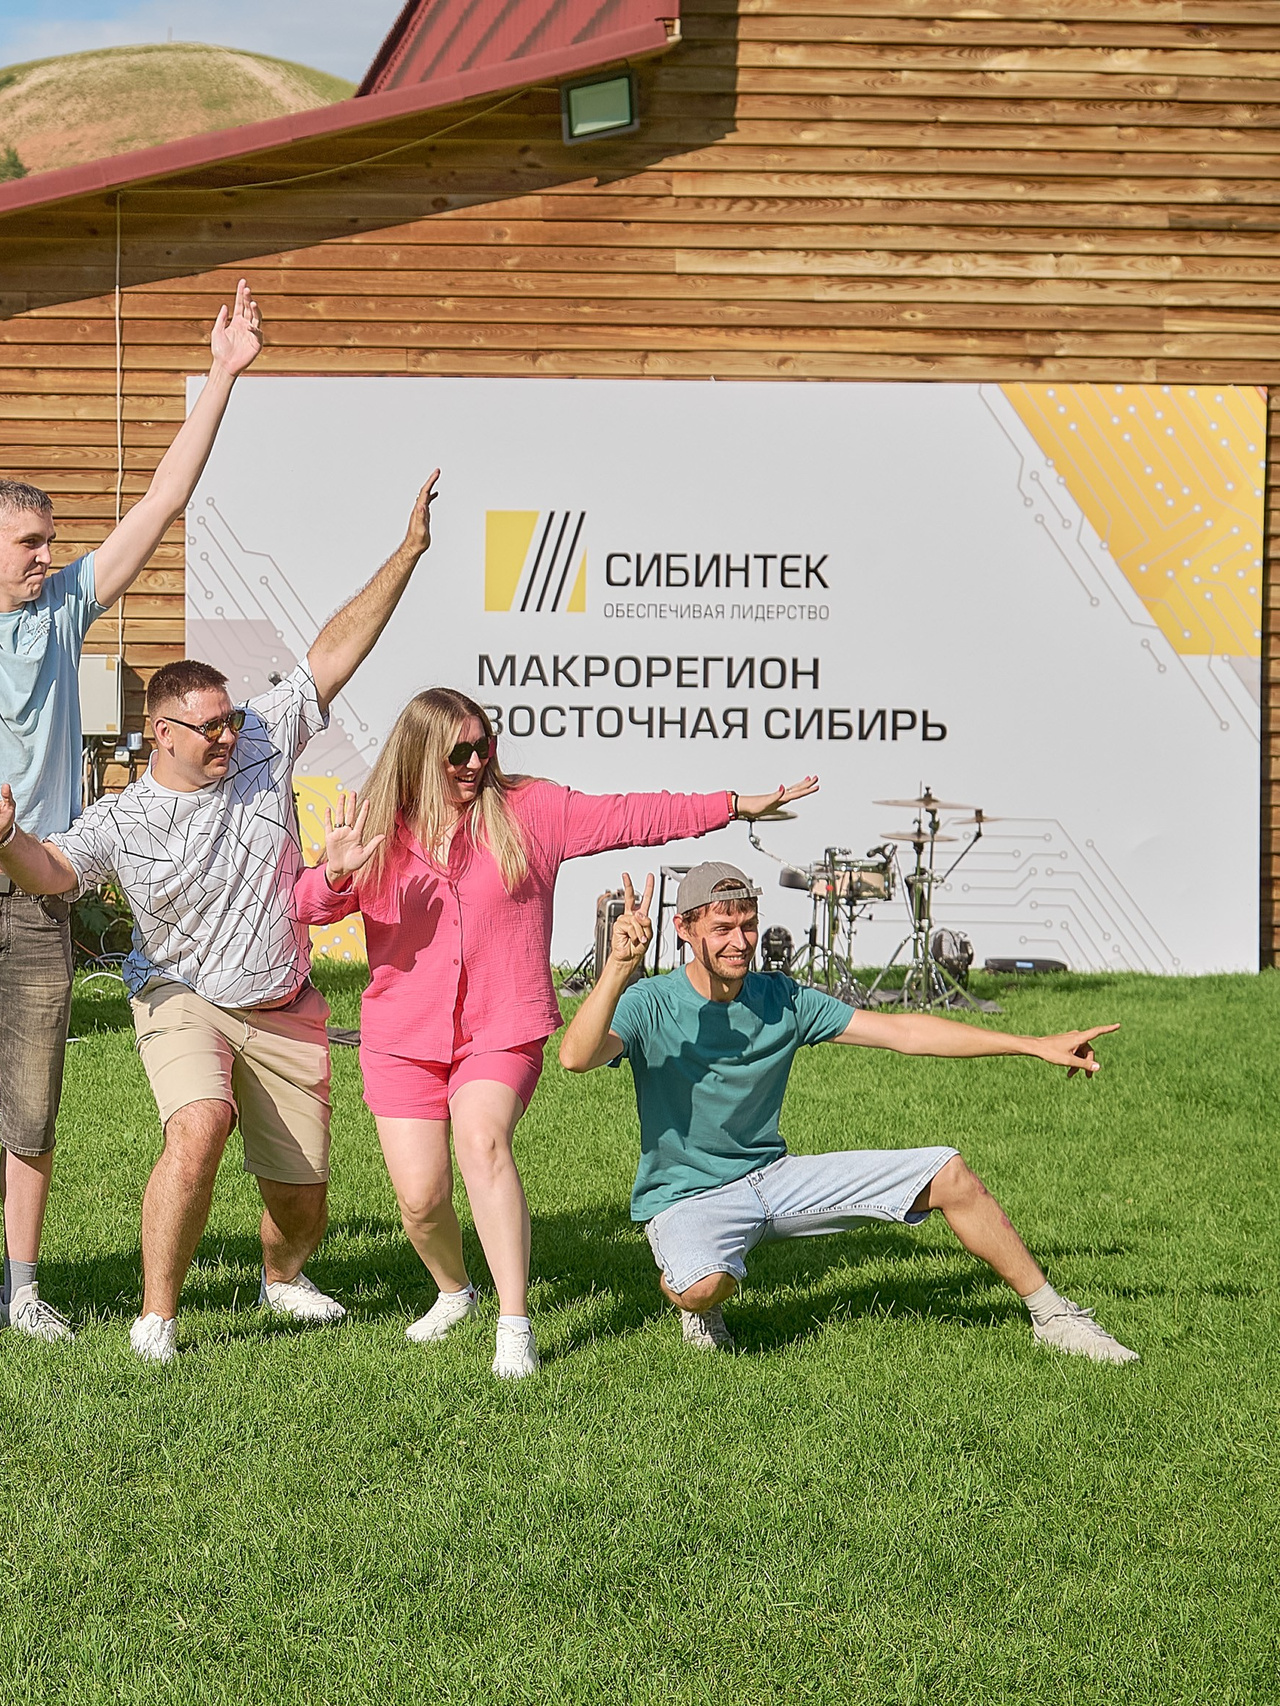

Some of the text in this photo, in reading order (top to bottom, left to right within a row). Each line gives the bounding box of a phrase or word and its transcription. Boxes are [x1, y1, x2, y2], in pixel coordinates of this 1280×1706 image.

[605, 553, 830, 589] СИБИНТЕК
[603, 603, 830, 622] ОБЕСПЕЧИВАЯ ЛИДЕРСТВО
[478, 654, 820, 690] МАКРОРЕГИОН
[763, 708, 948, 742] СИБИРЬ
